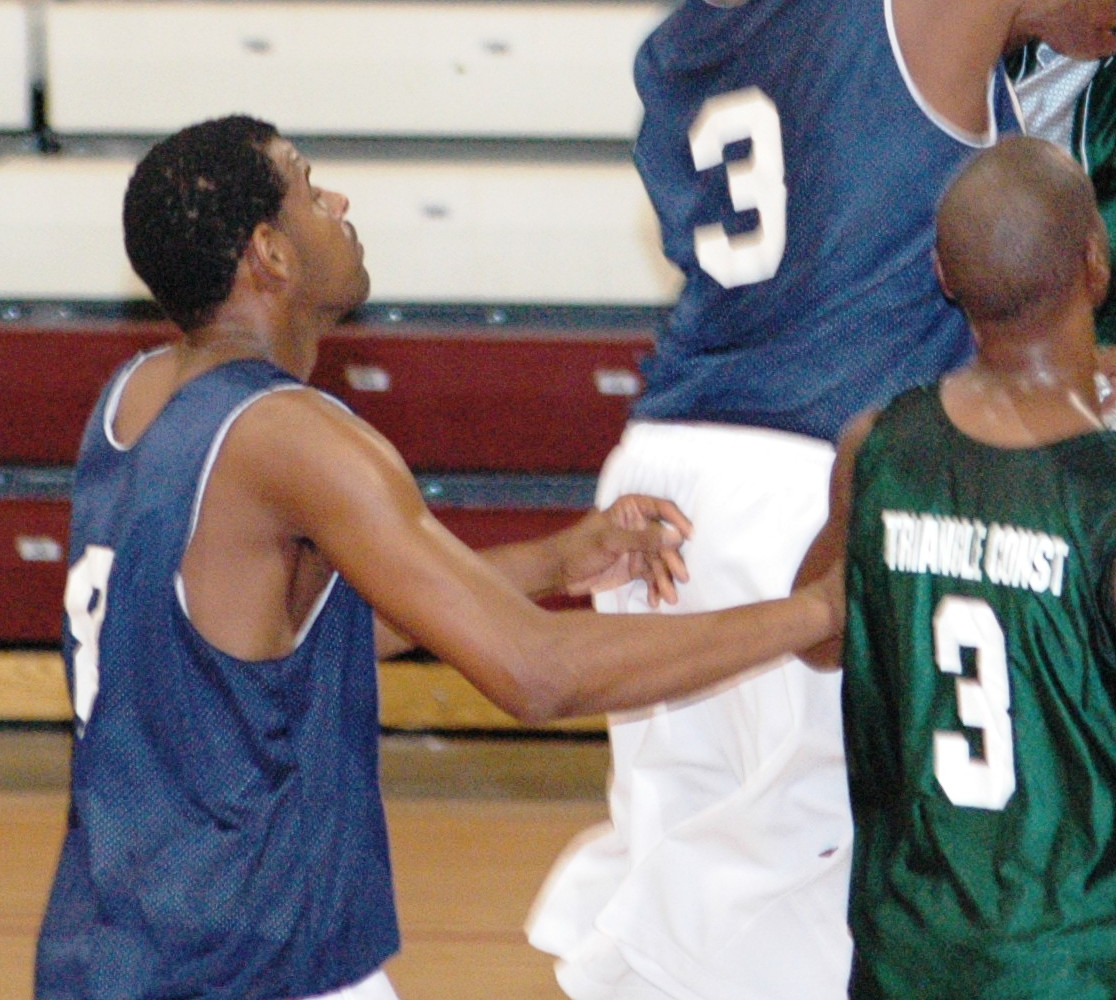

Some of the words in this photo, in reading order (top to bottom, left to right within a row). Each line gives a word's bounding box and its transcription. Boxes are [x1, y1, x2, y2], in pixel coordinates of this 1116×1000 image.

[688, 85, 787, 290] 3
[984, 520, 1070, 597] CONST
[933, 594, 1017, 811] 3
